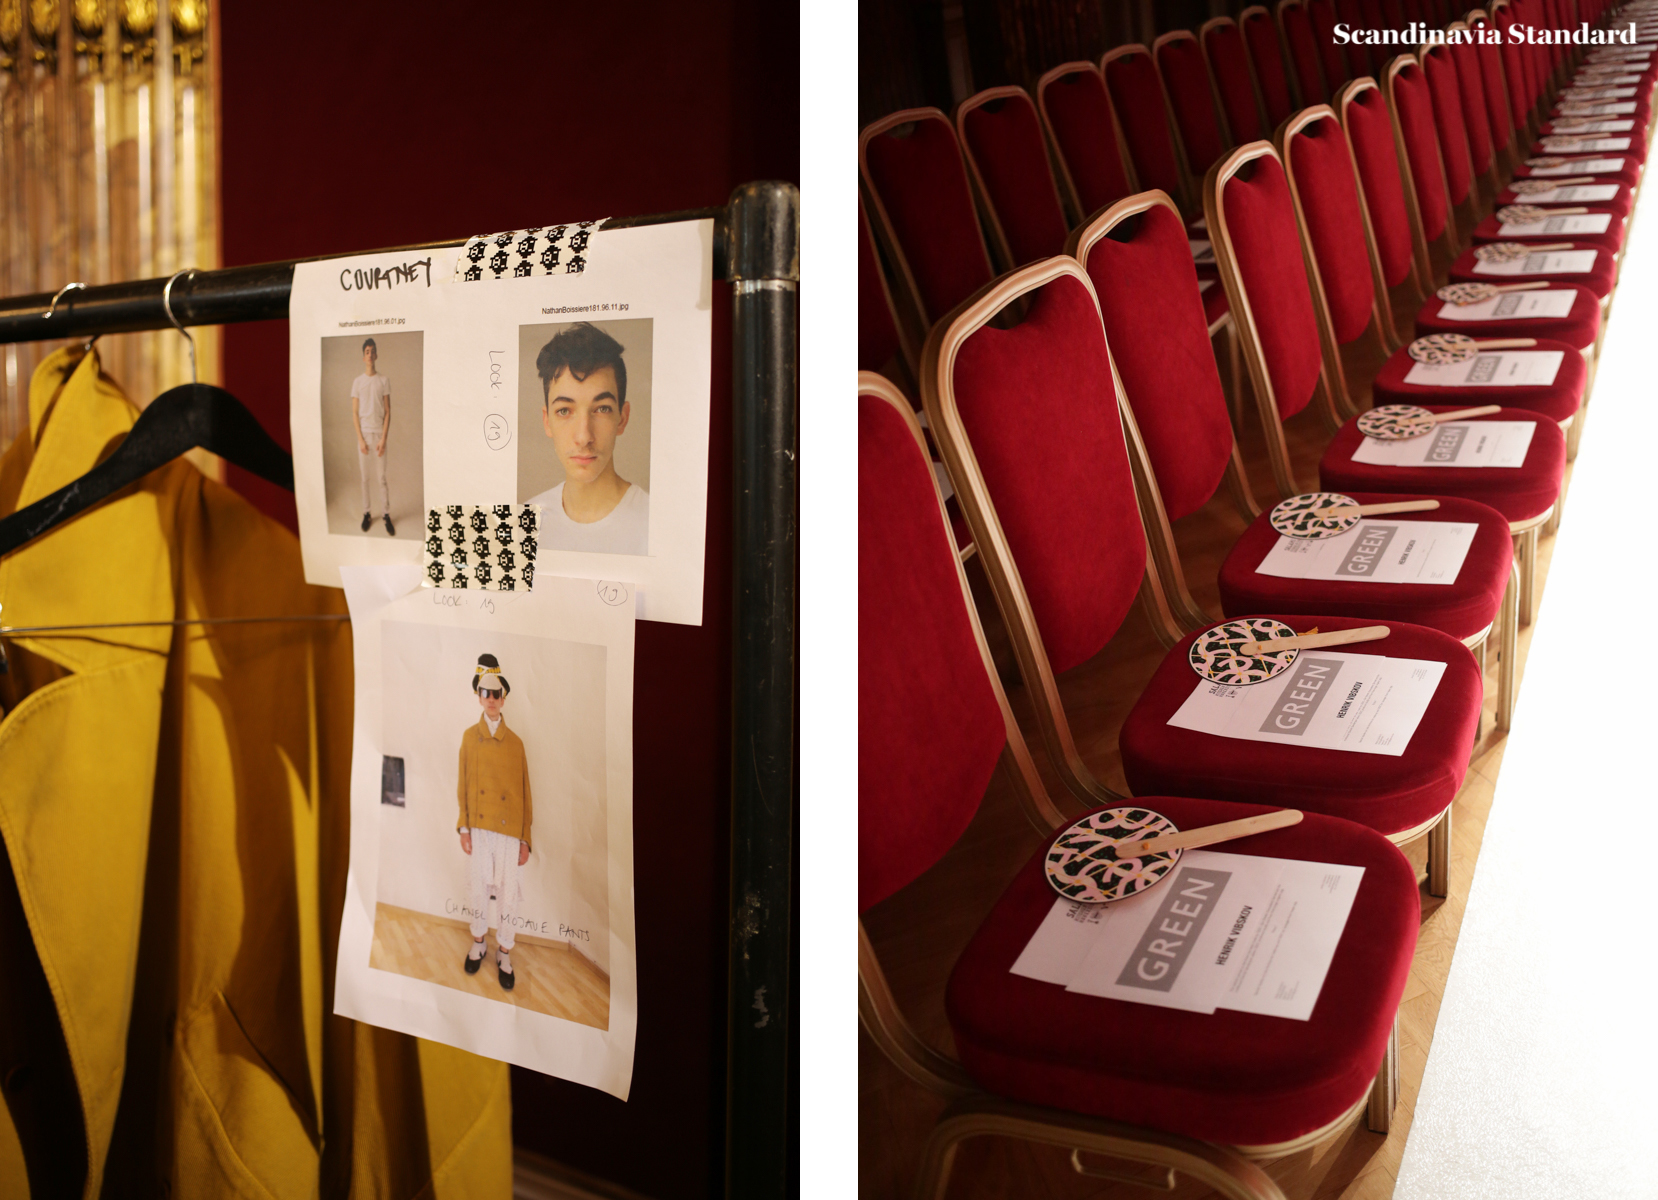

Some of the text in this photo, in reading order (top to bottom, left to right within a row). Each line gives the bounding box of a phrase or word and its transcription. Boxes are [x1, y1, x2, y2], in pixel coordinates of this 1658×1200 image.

[340, 257, 431, 291] COURTNEY
[541, 303, 629, 315] NathanBoissiere181.96.11.jpg
[1432, 428, 1462, 461] GREEN
[1347, 529, 1389, 573] GREEN
[1275, 664, 1331, 730] GREEN
[1336, 681, 1363, 719] HENRIK VIBSKOV
[559, 923, 590, 942] PANTS
[1137, 877, 1215, 982] GREEN
[1215, 904, 1253, 966] HENRIK VIBSKOV
